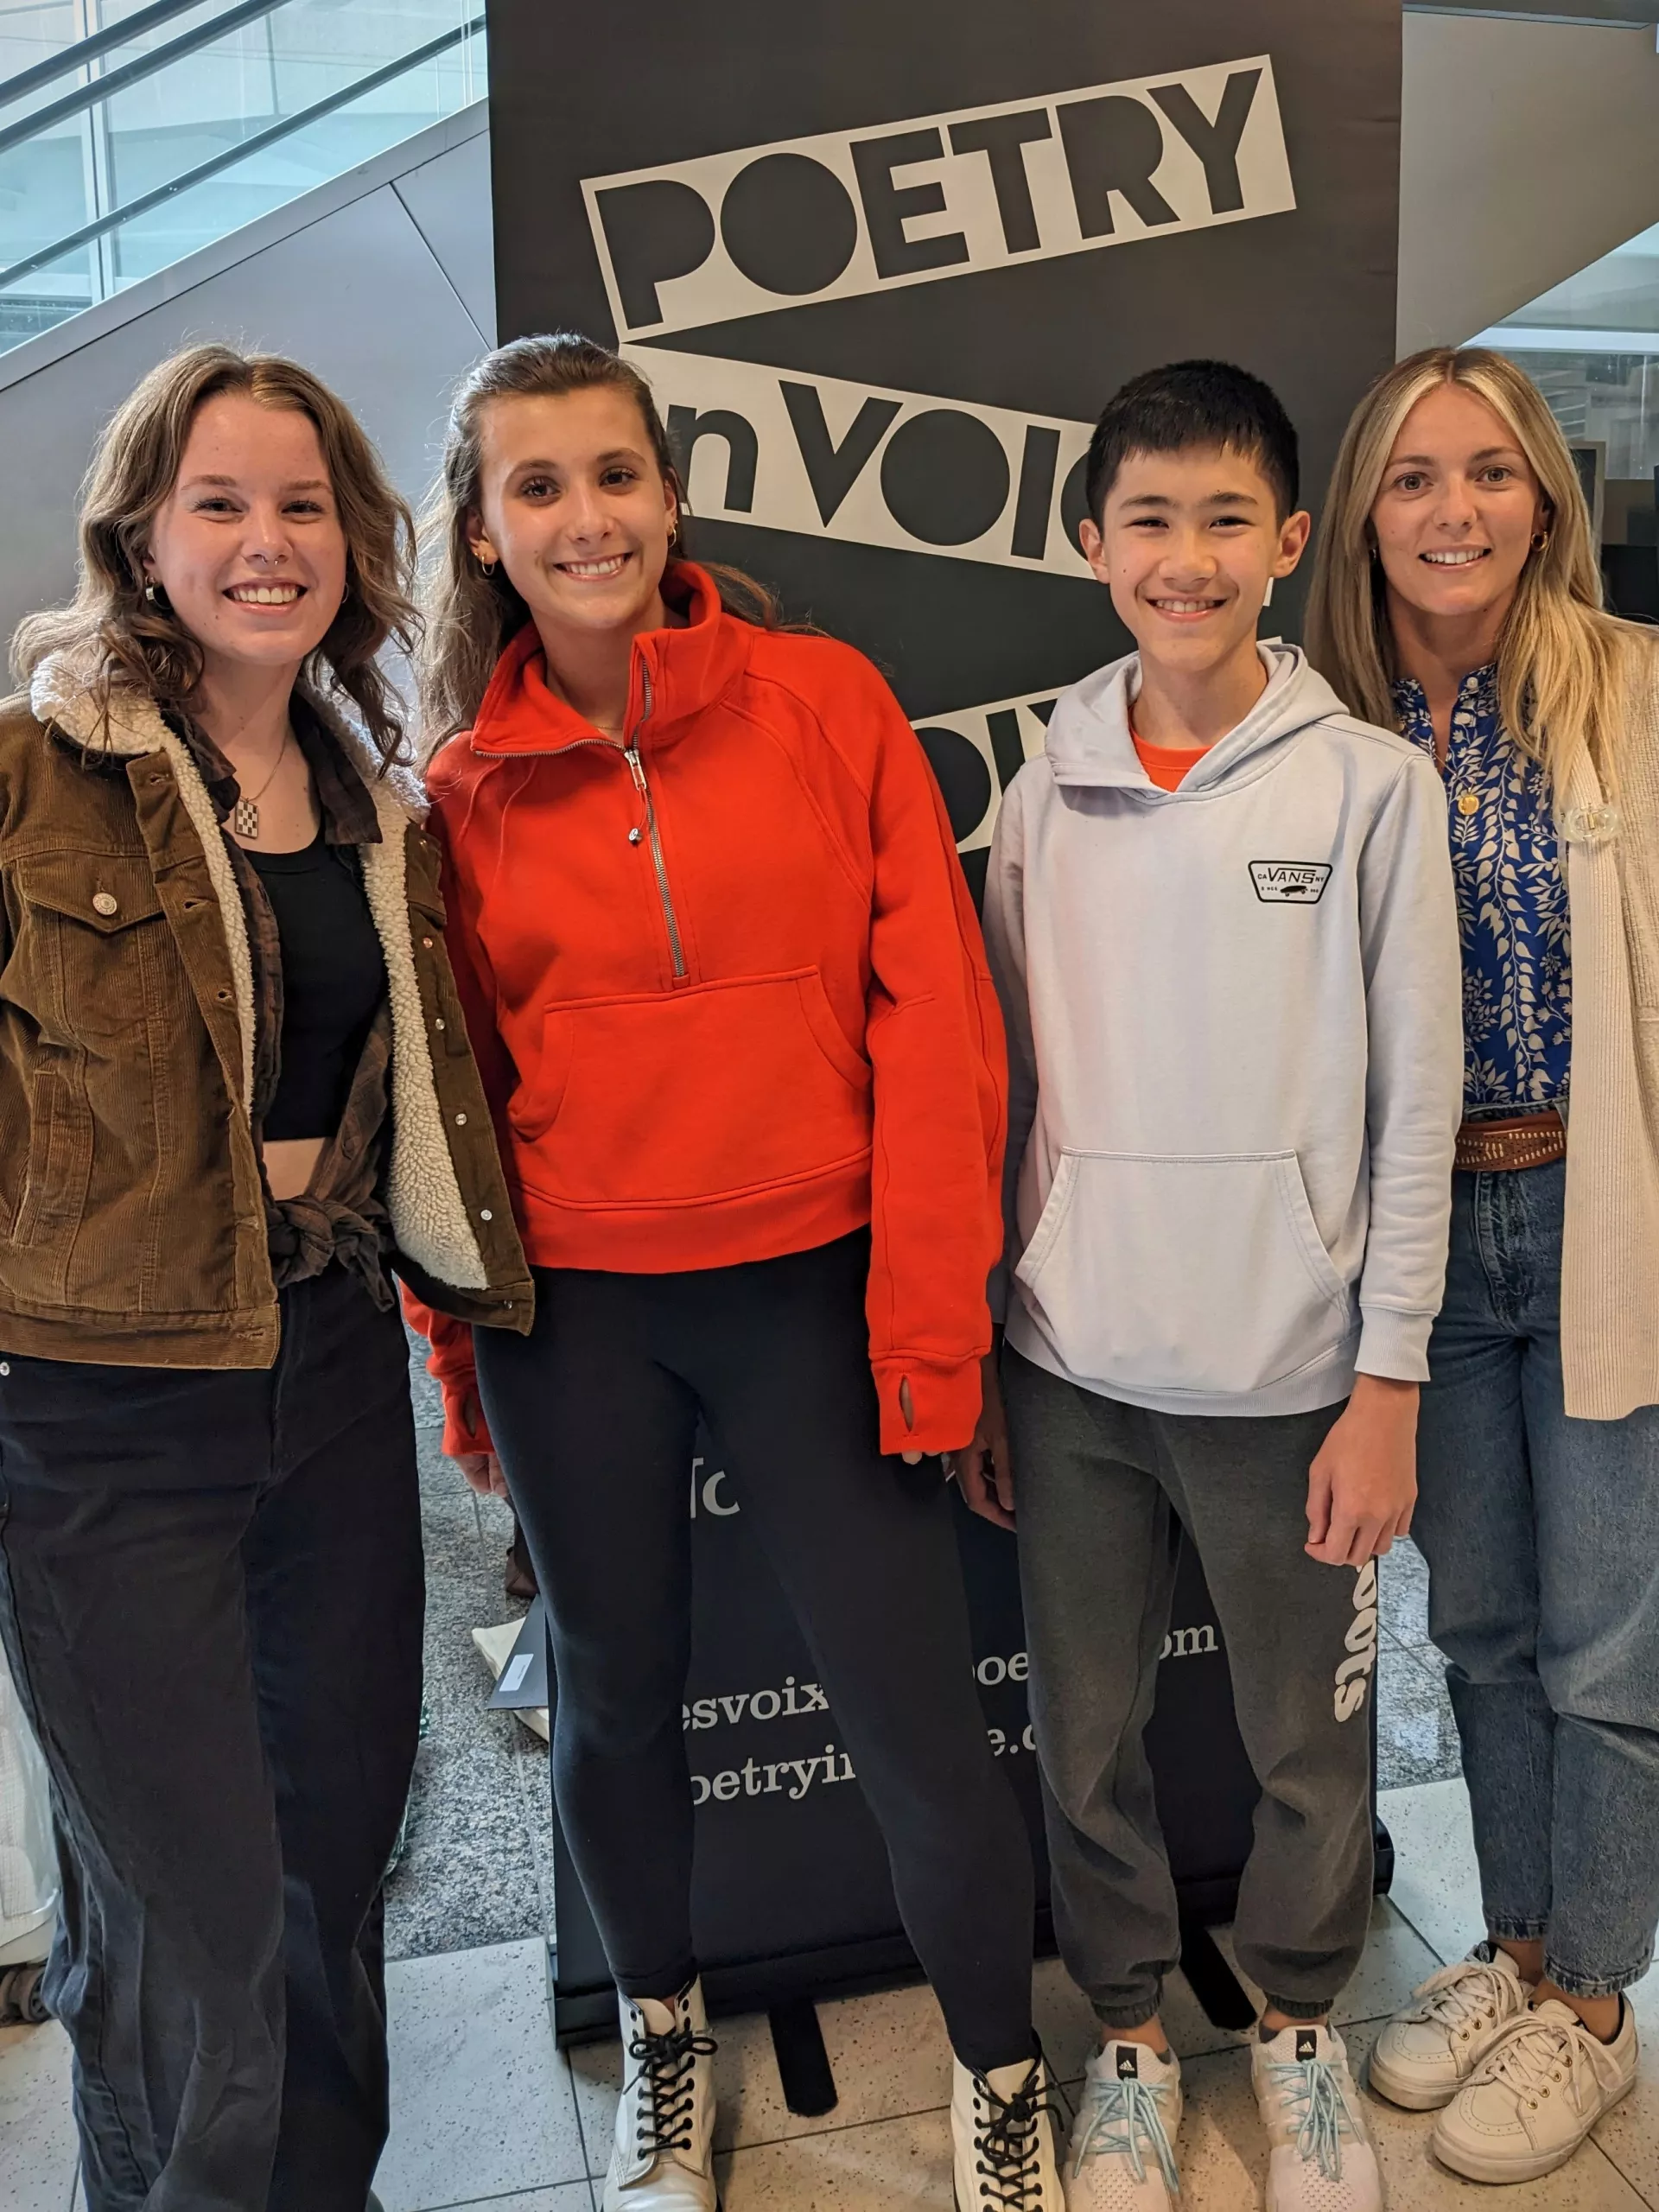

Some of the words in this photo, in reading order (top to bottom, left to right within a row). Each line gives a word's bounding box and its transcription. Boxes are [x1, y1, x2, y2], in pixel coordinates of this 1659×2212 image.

[594, 68, 1263, 330] POETRY
[1268, 867, 1317, 884] VANS
[1334, 1560, 1377, 1722] oots
